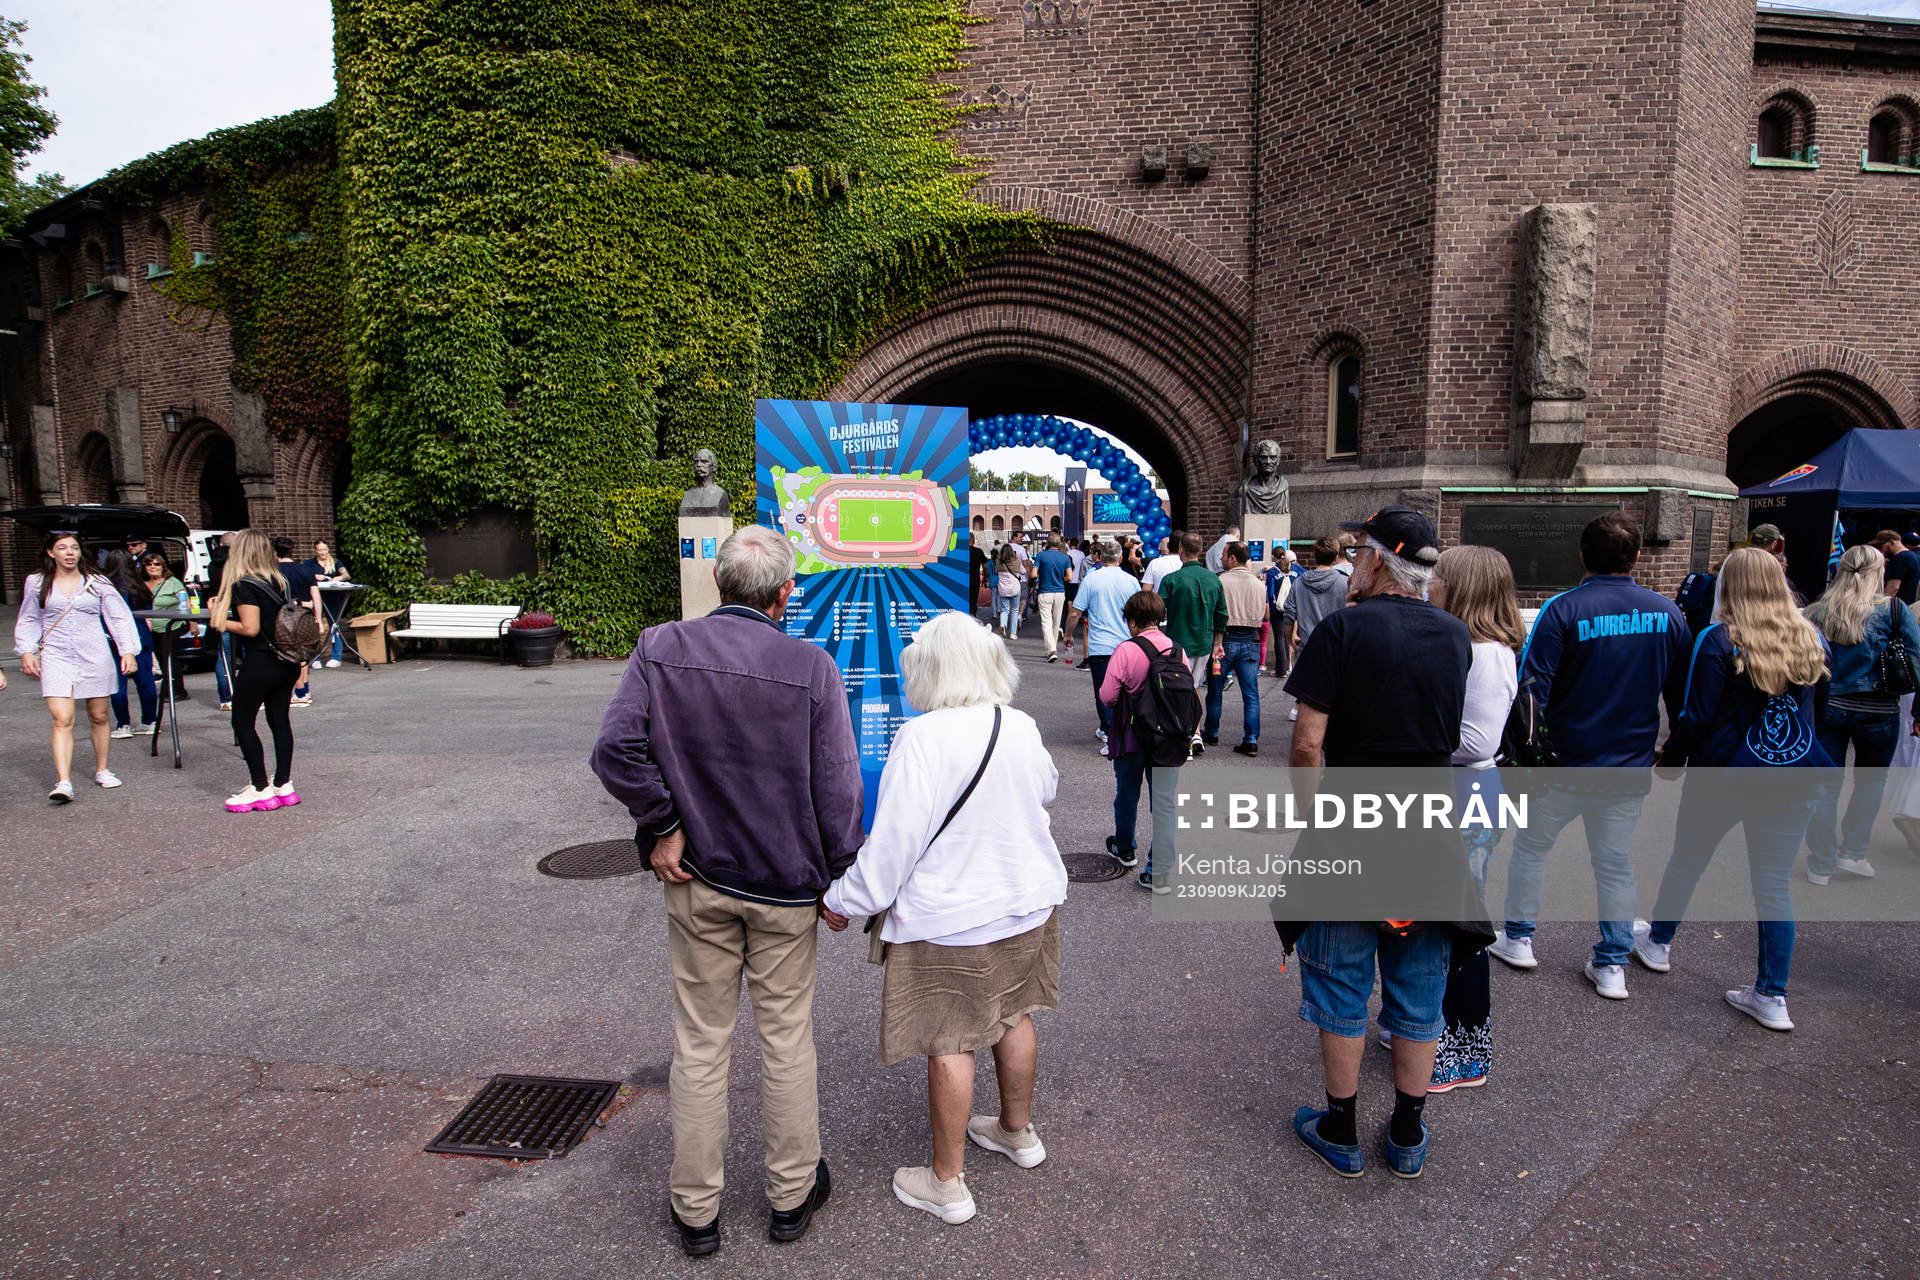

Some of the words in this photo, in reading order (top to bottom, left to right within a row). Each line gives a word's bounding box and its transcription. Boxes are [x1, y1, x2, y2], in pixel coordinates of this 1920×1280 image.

[829, 418, 899, 440] DJURGÅRDS
[842, 434, 899, 454] FESTIVALEN
[1578, 609, 1669, 641] DJURGÅR'N
[862, 703, 890, 713] PROGRAM
[1754, 740, 1808, 762] STOTHET
